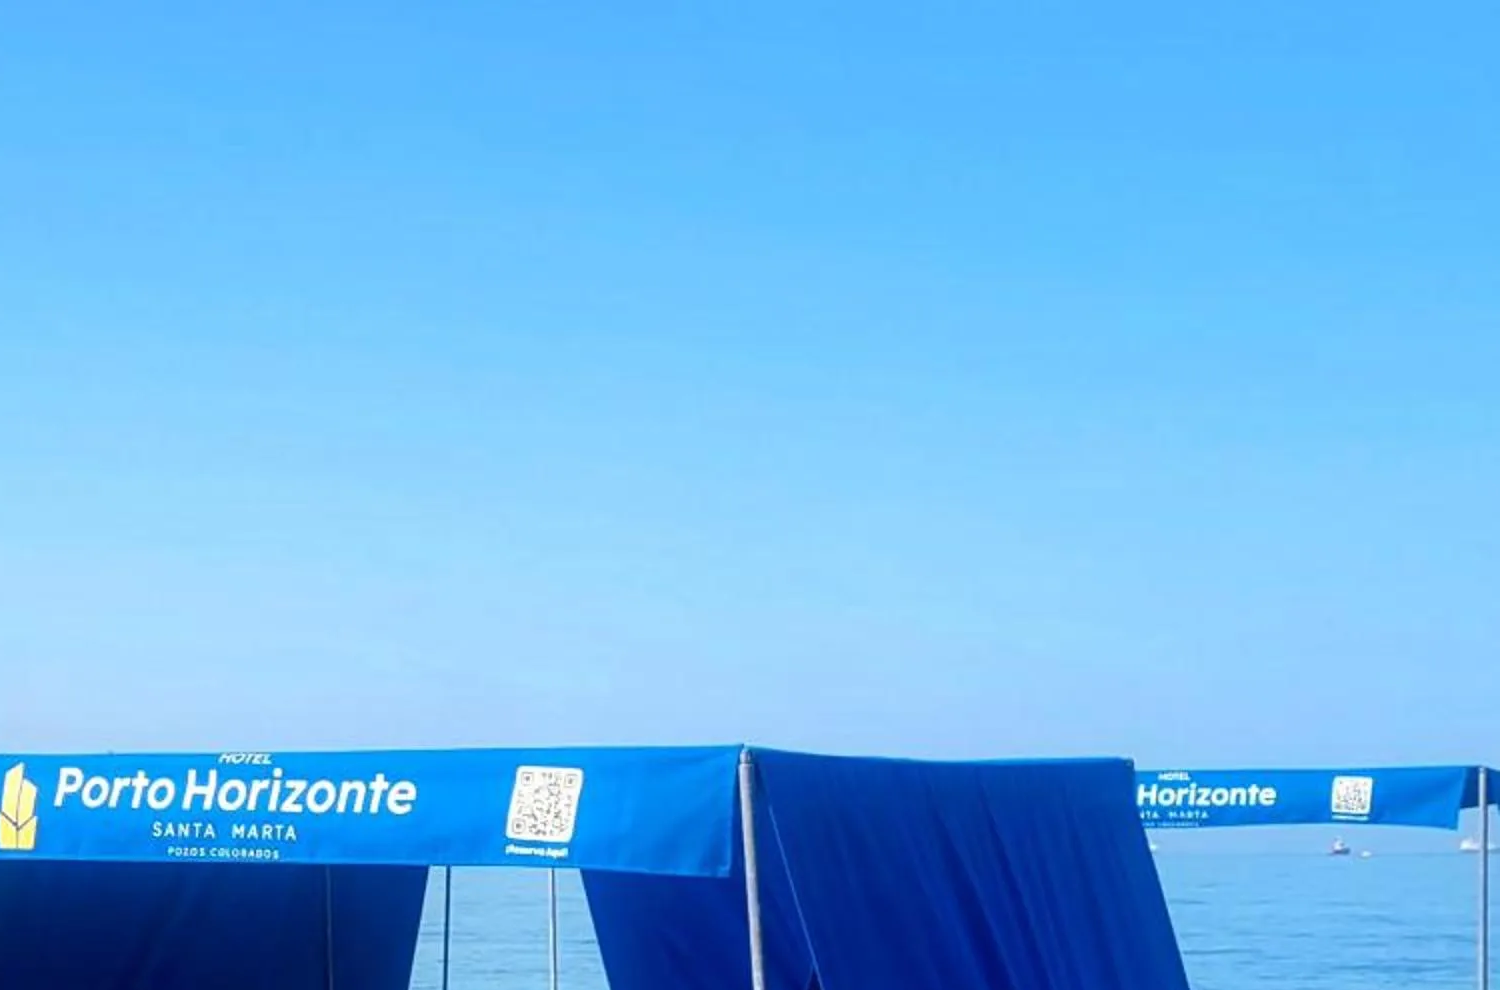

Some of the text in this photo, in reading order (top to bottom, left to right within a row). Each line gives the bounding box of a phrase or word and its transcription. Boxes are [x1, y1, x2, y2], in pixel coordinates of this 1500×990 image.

[217, 752, 272, 765] HOTEL
[53, 766, 417, 816] Porto Horizonte
[1137, 783, 1276, 806] Horizonte
[152, 820, 298, 842] SANTA MARTA
